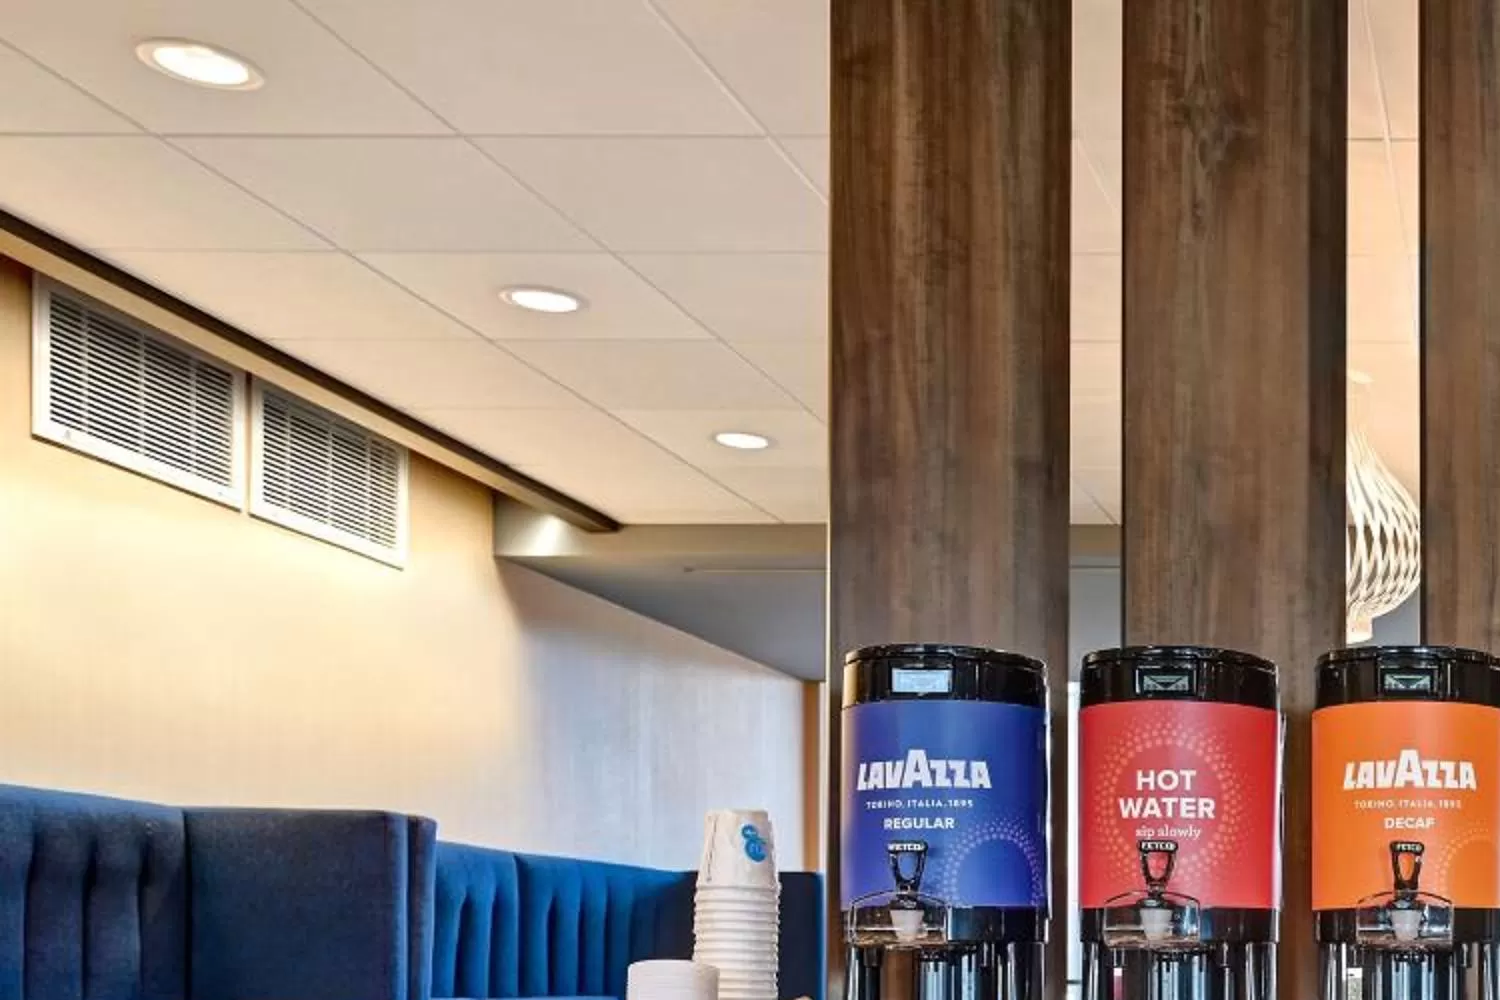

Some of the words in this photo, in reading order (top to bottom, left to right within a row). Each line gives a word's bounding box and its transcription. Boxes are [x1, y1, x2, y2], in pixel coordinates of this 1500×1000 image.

[857, 750, 992, 791] LAVAZZA
[1136, 769, 1197, 791] HOT
[1343, 750, 1477, 791] LAVAZZA
[1119, 798, 1216, 819] WATER
[883, 818, 955, 829] REGULAR
[1157, 824, 1201, 841] slowly
[1384, 817, 1436, 829] DECAF
